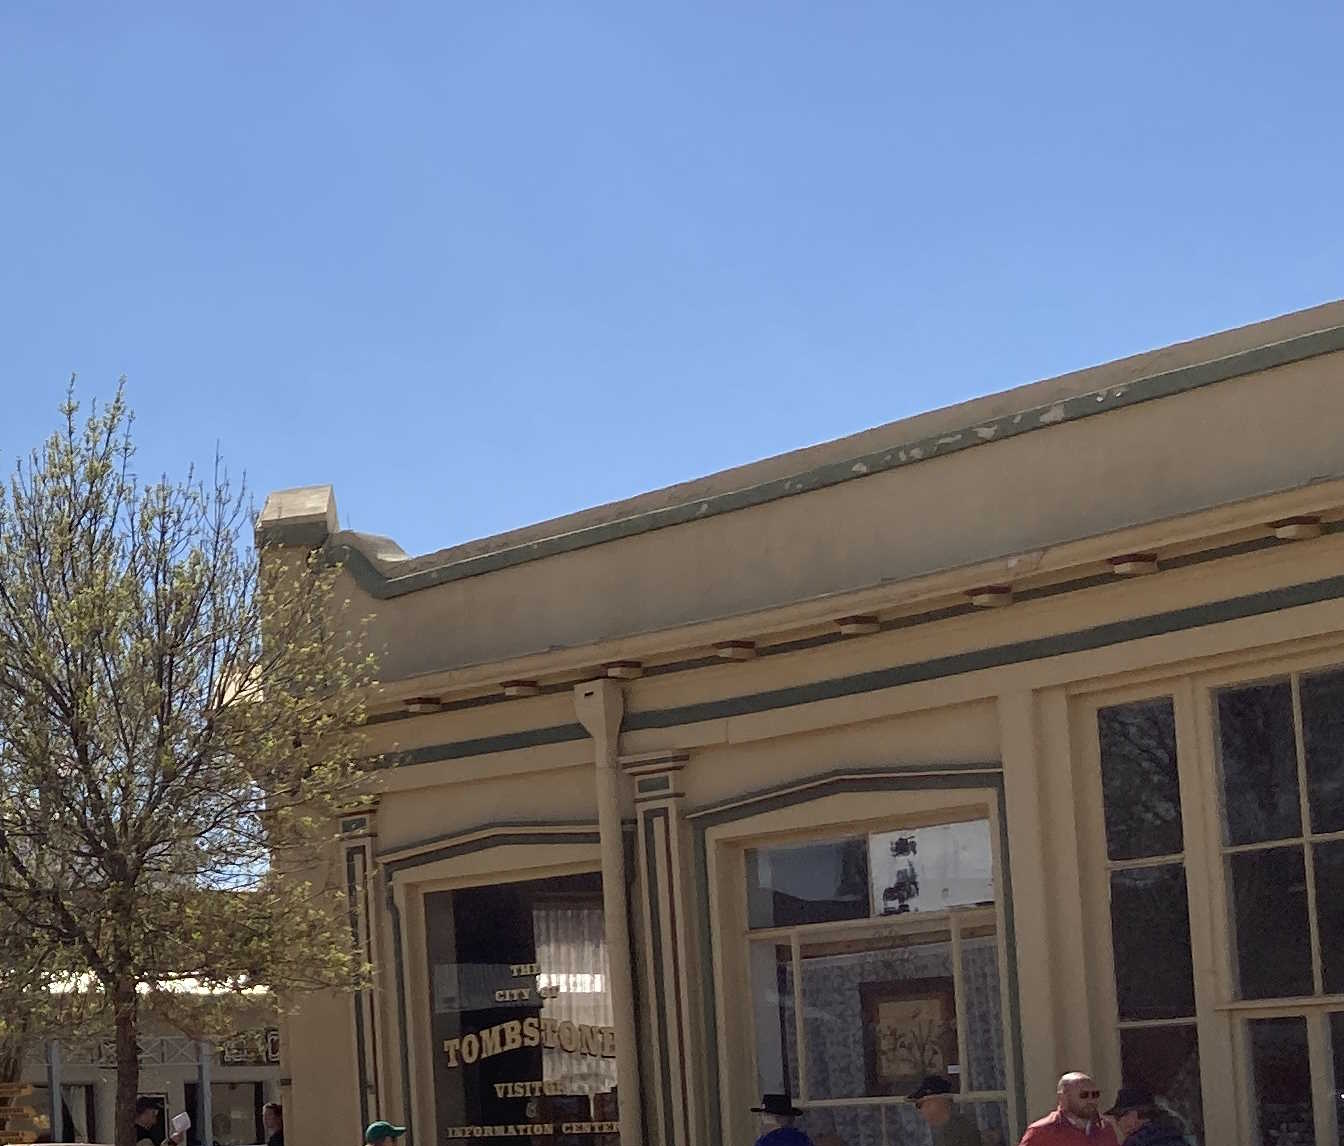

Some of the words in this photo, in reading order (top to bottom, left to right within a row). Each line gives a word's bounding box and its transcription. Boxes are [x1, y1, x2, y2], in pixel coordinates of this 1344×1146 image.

[510, 964, 542, 977] THE
[495, 987, 530, 1002] CITY
[443, 1016, 616, 1068] TOMBSTONE
[447, 1123, 553, 1139] INFORMATION
